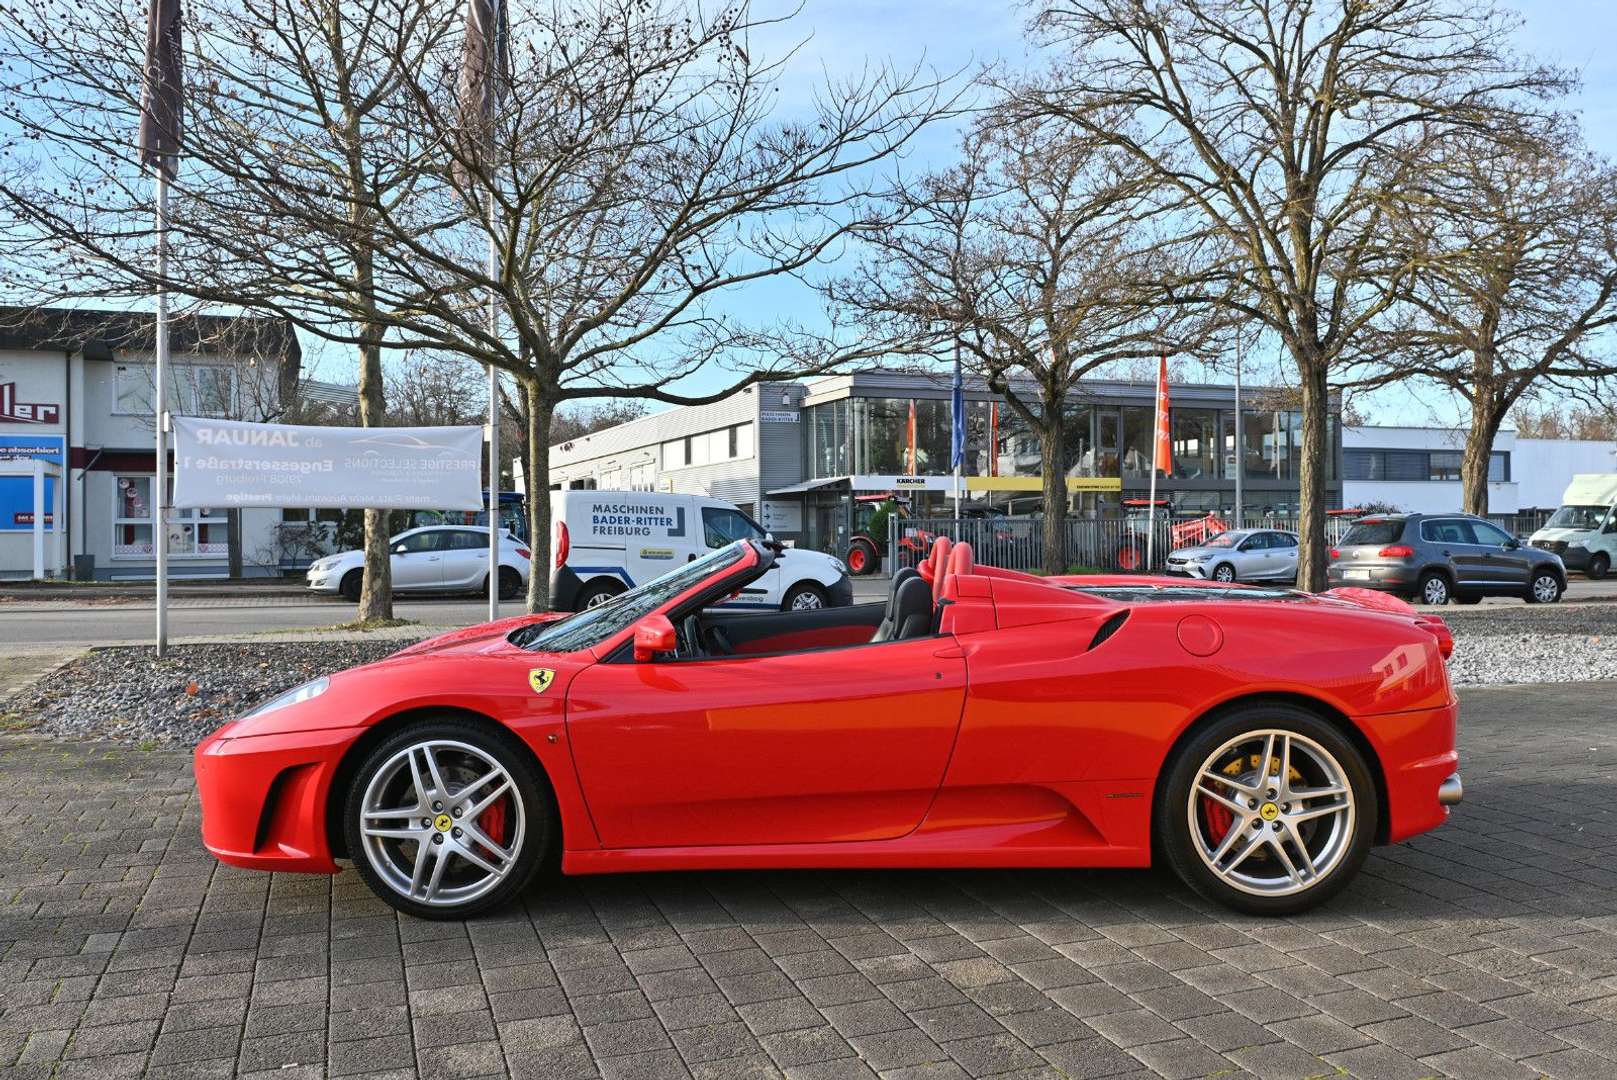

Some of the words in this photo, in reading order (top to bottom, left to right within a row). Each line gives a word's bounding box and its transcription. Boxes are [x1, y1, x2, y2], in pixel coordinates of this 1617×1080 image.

[592, 504, 664, 515] MASCHINEN
[592, 515, 673, 526] BADER-RITTER
[592, 526, 651, 536] FREIBURG
